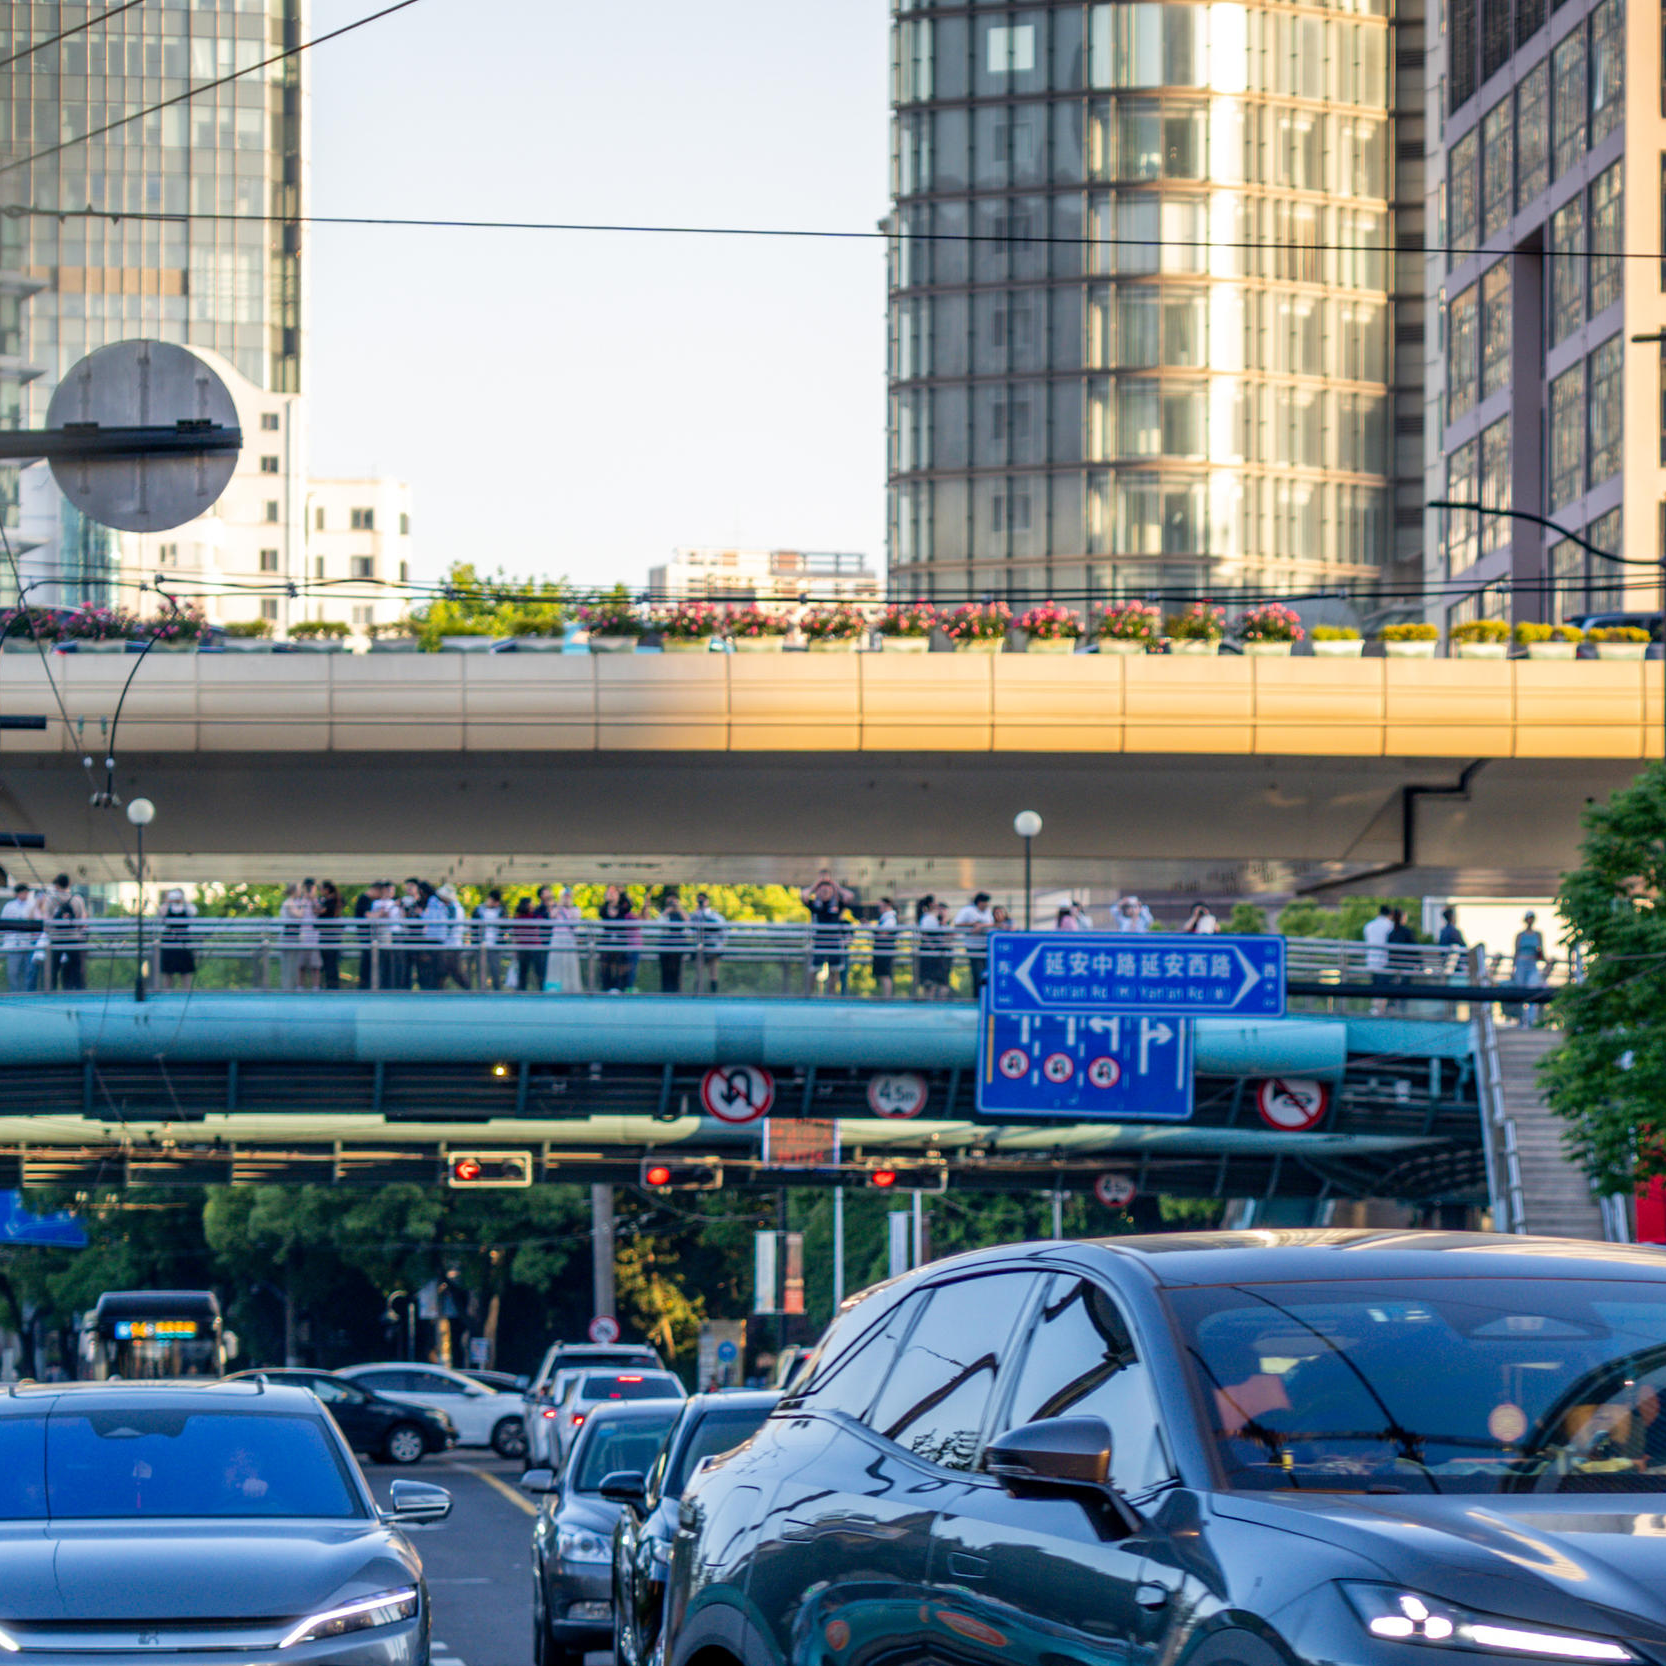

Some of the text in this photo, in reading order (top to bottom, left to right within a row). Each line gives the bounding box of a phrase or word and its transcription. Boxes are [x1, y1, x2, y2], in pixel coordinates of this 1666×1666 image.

[1045, 952, 1230, 979] 延安中路 延安西路
